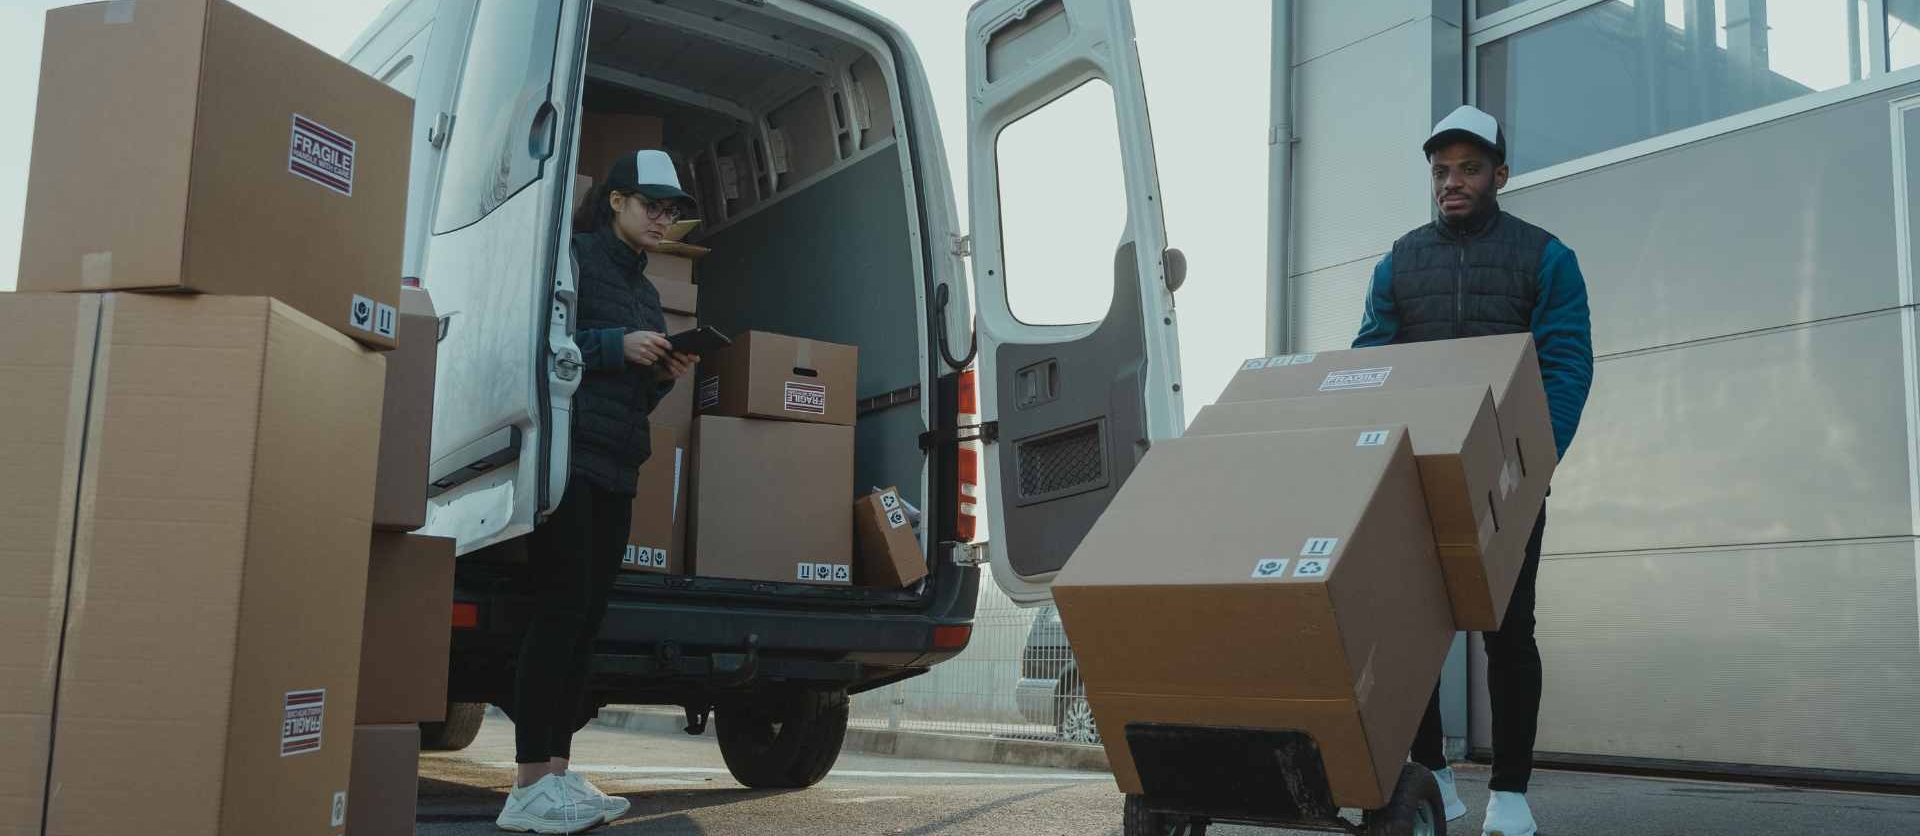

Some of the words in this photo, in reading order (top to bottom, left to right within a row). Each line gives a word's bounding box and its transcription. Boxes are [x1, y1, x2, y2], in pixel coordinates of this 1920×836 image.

[293, 132, 352, 171] FRAGILE
[787, 393, 823, 406] FRAGILE
[284, 715, 321, 735] FRAGILE
